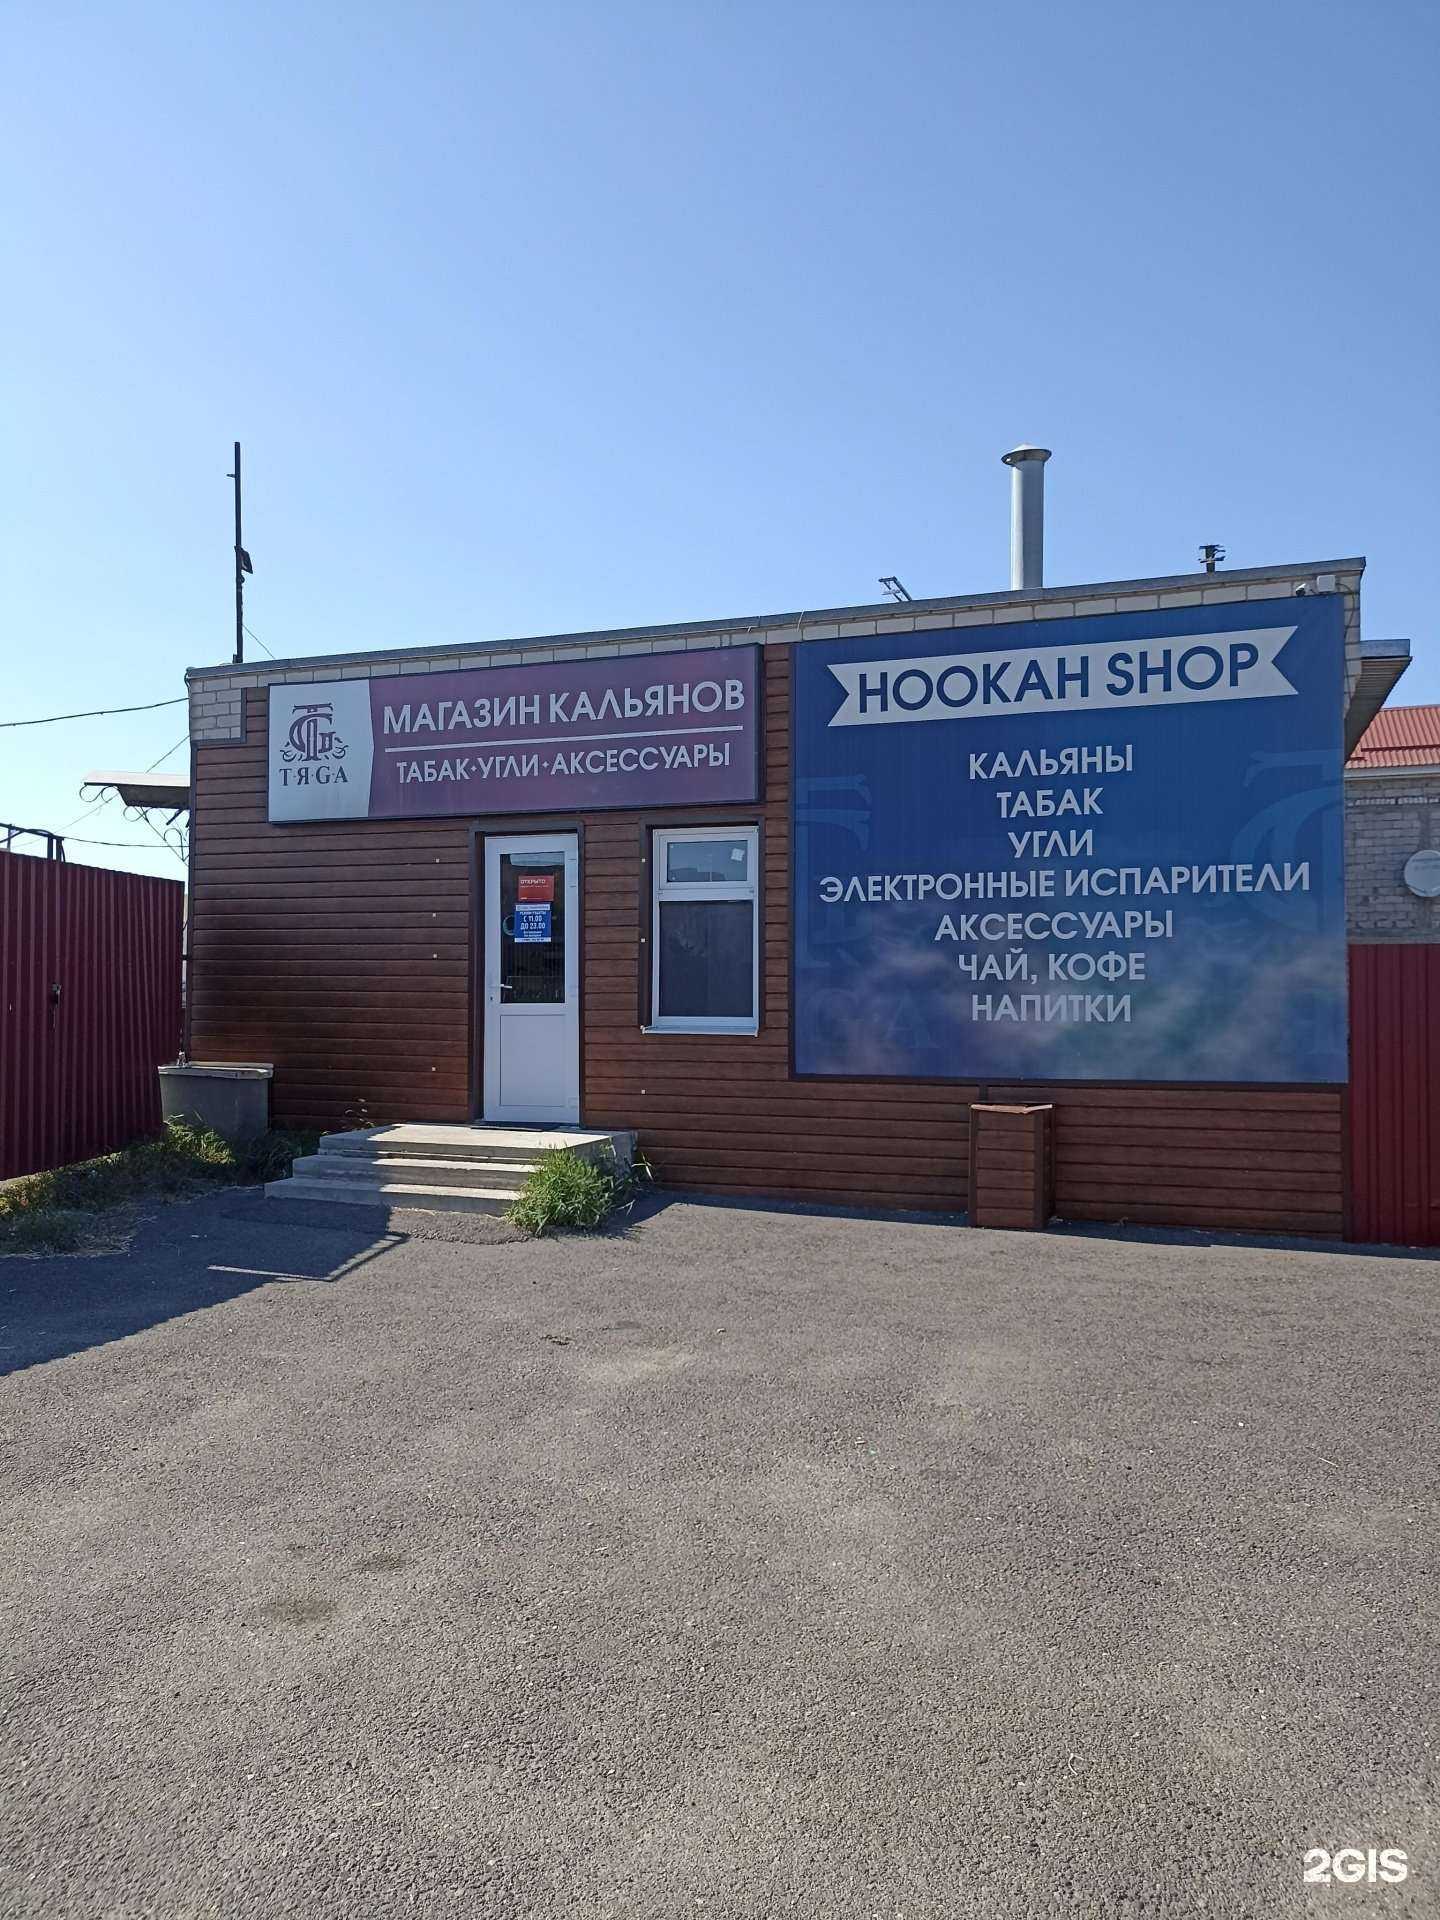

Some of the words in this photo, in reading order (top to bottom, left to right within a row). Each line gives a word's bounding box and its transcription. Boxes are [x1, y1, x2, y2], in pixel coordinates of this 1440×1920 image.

[859, 655, 1090, 713] HOOKAH
[1105, 642, 1260, 696] SHOP
[383, 694, 541, 735] МАГАЗИН
[550, 679, 746, 723] КАЛЬЯНОВ
[968, 744, 1134, 780] КАЛЬЯНЫ
[996, 787, 1104, 819] ТАБАК
[1007, 829, 1094, 859] УГЛИ
[819, 869, 1056, 903] ЭЛЕКТРОННЫЕ
[1065, 862, 1311, 897] ИСПАРИТЕЛИ
[934, 910, 1174, 942] АКСЕССУАРЫ
[958, 948, 1038, 986] ЧАЙ,
[1048, 951, 1146, 982] КОФЕ
[971, 994, 1133, 1023] НАПИТКИ
